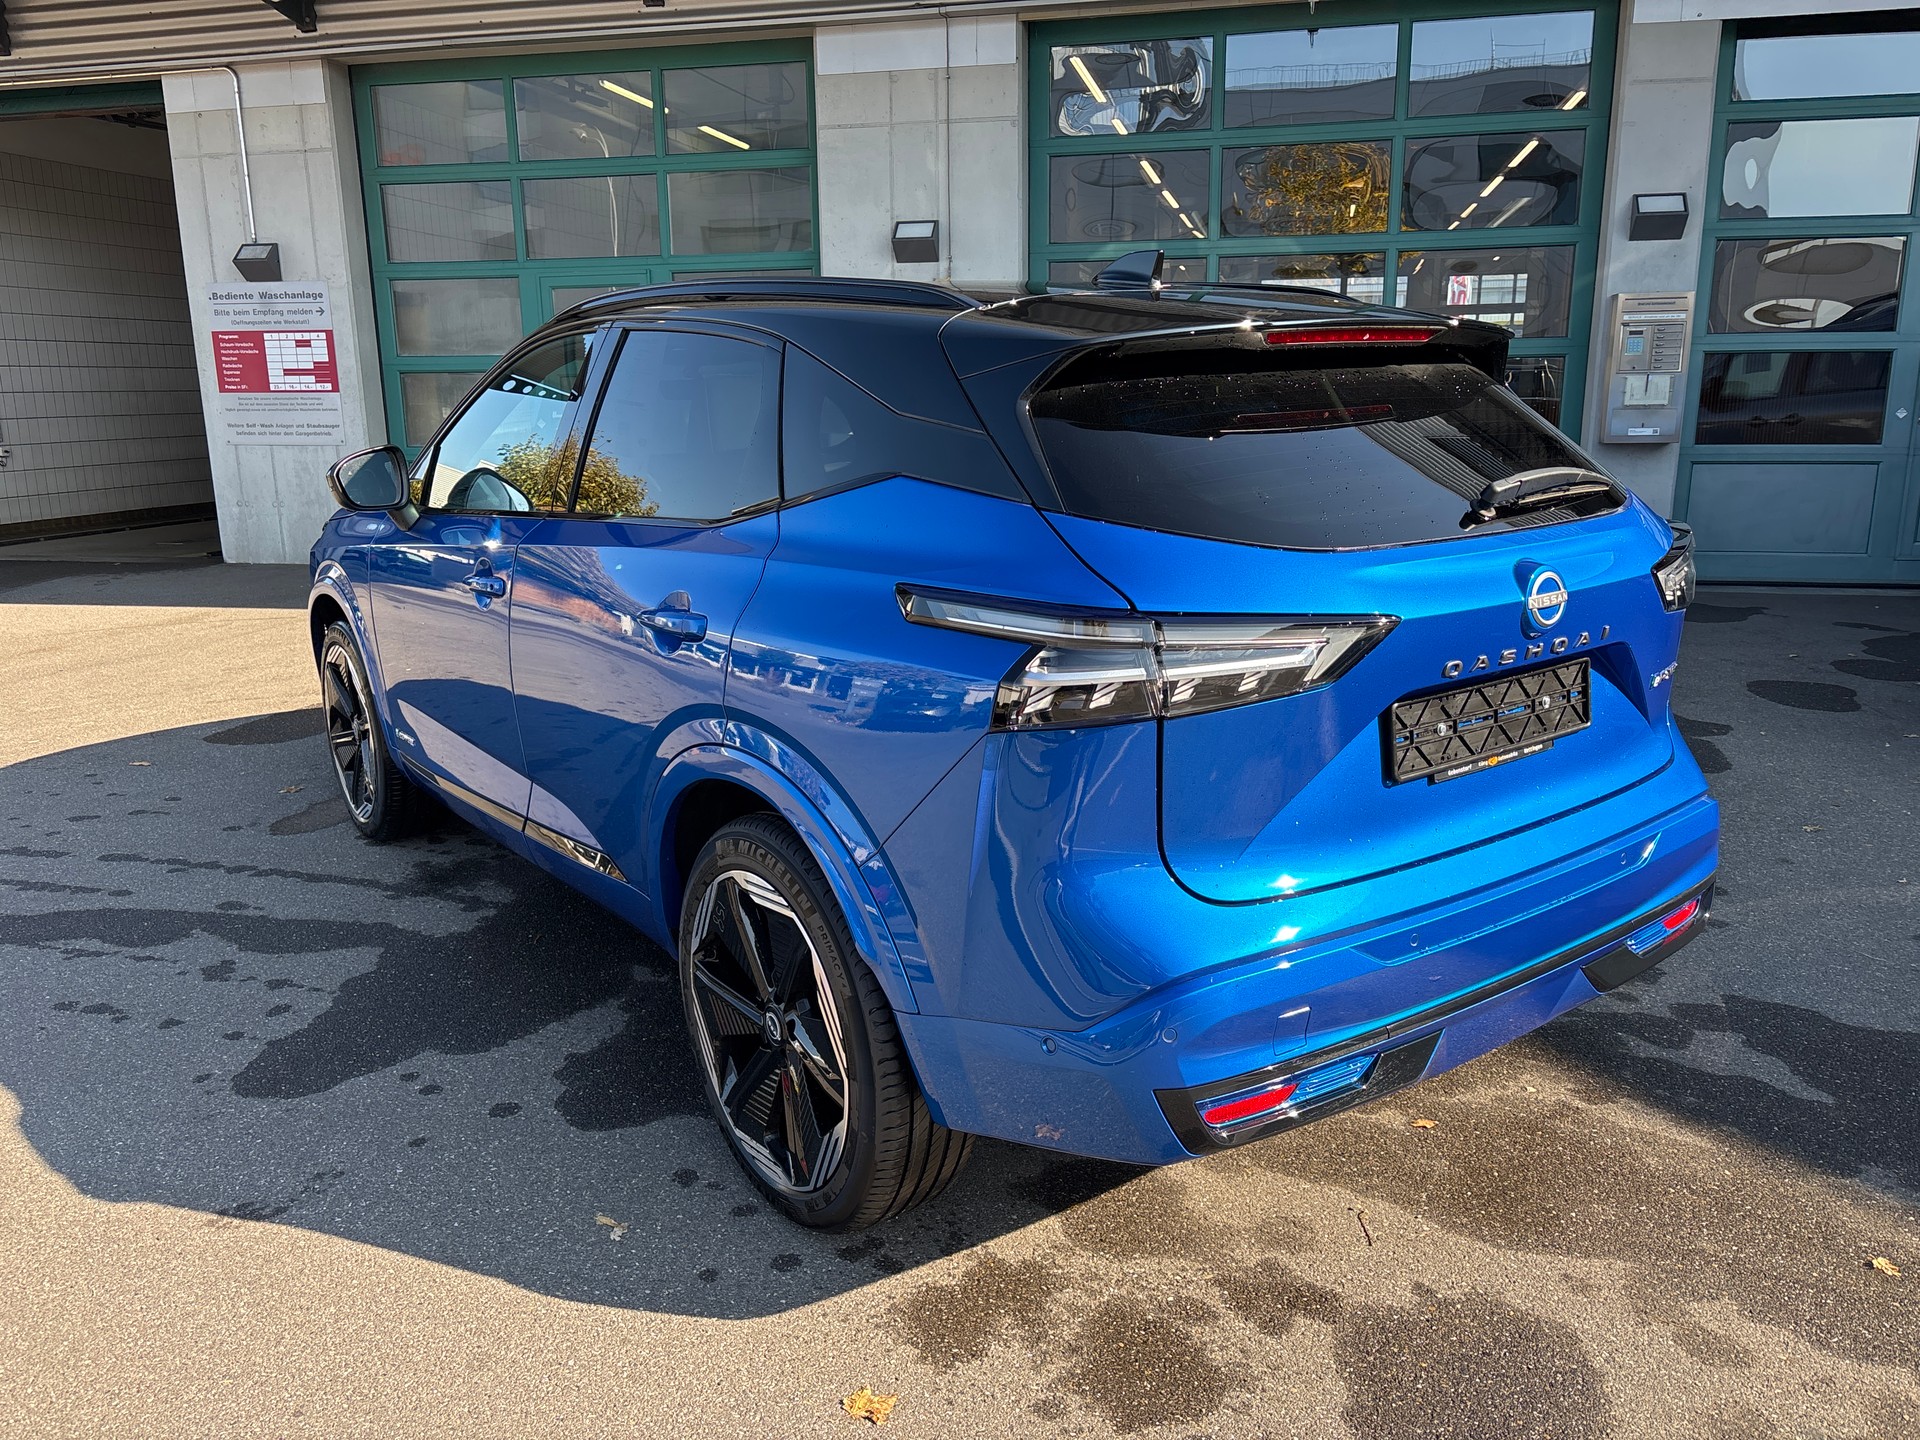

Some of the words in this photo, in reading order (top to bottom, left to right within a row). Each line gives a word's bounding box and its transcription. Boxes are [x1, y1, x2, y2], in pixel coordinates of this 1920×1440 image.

[212, 291, 254, 301] Bediente
[258, 291, 324, 301] Waschanlage
[214, 308, 230, 316] Bitte
[233, 308, 250, 316] beim
[253, 308, 284, 317] Empfang
[1529, 591, 1568, 609] NISSAN
[1441, 625, 1611, 678] QASHQAI
[738, 840, 812, 910] MICHELIN
[817, 925, 845, 980] PRIMACY
